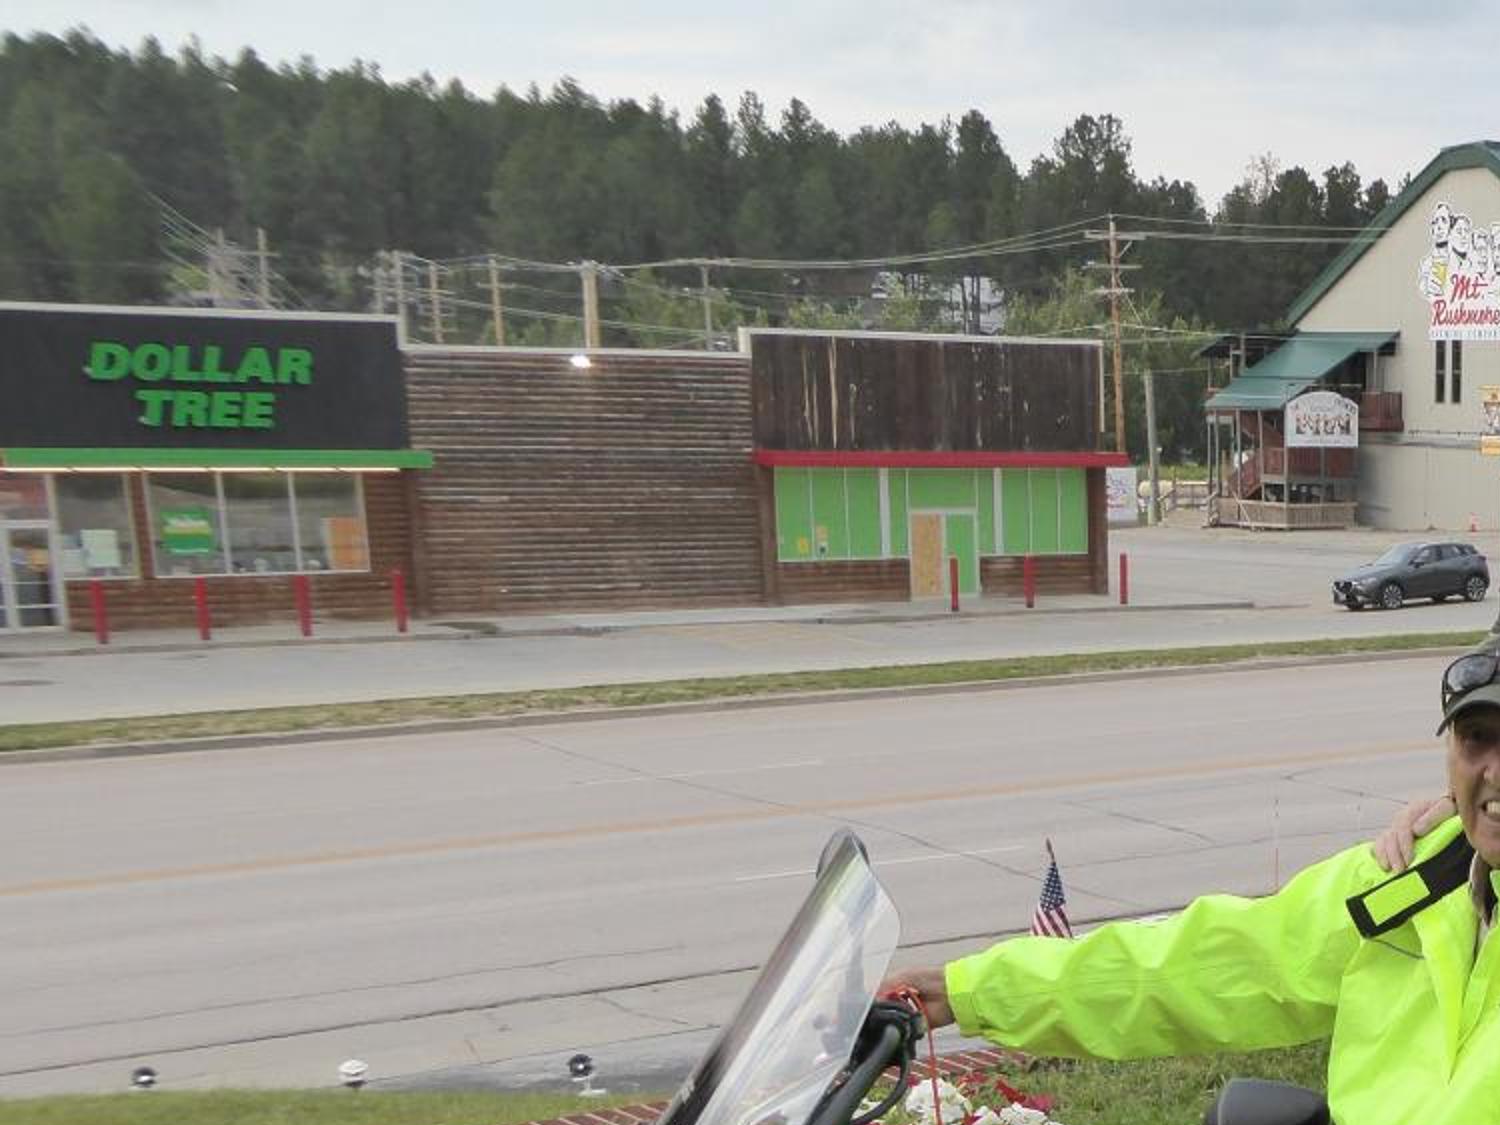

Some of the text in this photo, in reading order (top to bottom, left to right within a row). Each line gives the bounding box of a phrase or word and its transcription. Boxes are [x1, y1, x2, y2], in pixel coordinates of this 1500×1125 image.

[1449, 273, 1489, 304] Mt.
[89, 341, 313, 384] DOLLAR
[133, 388, 276, 428] TREE
